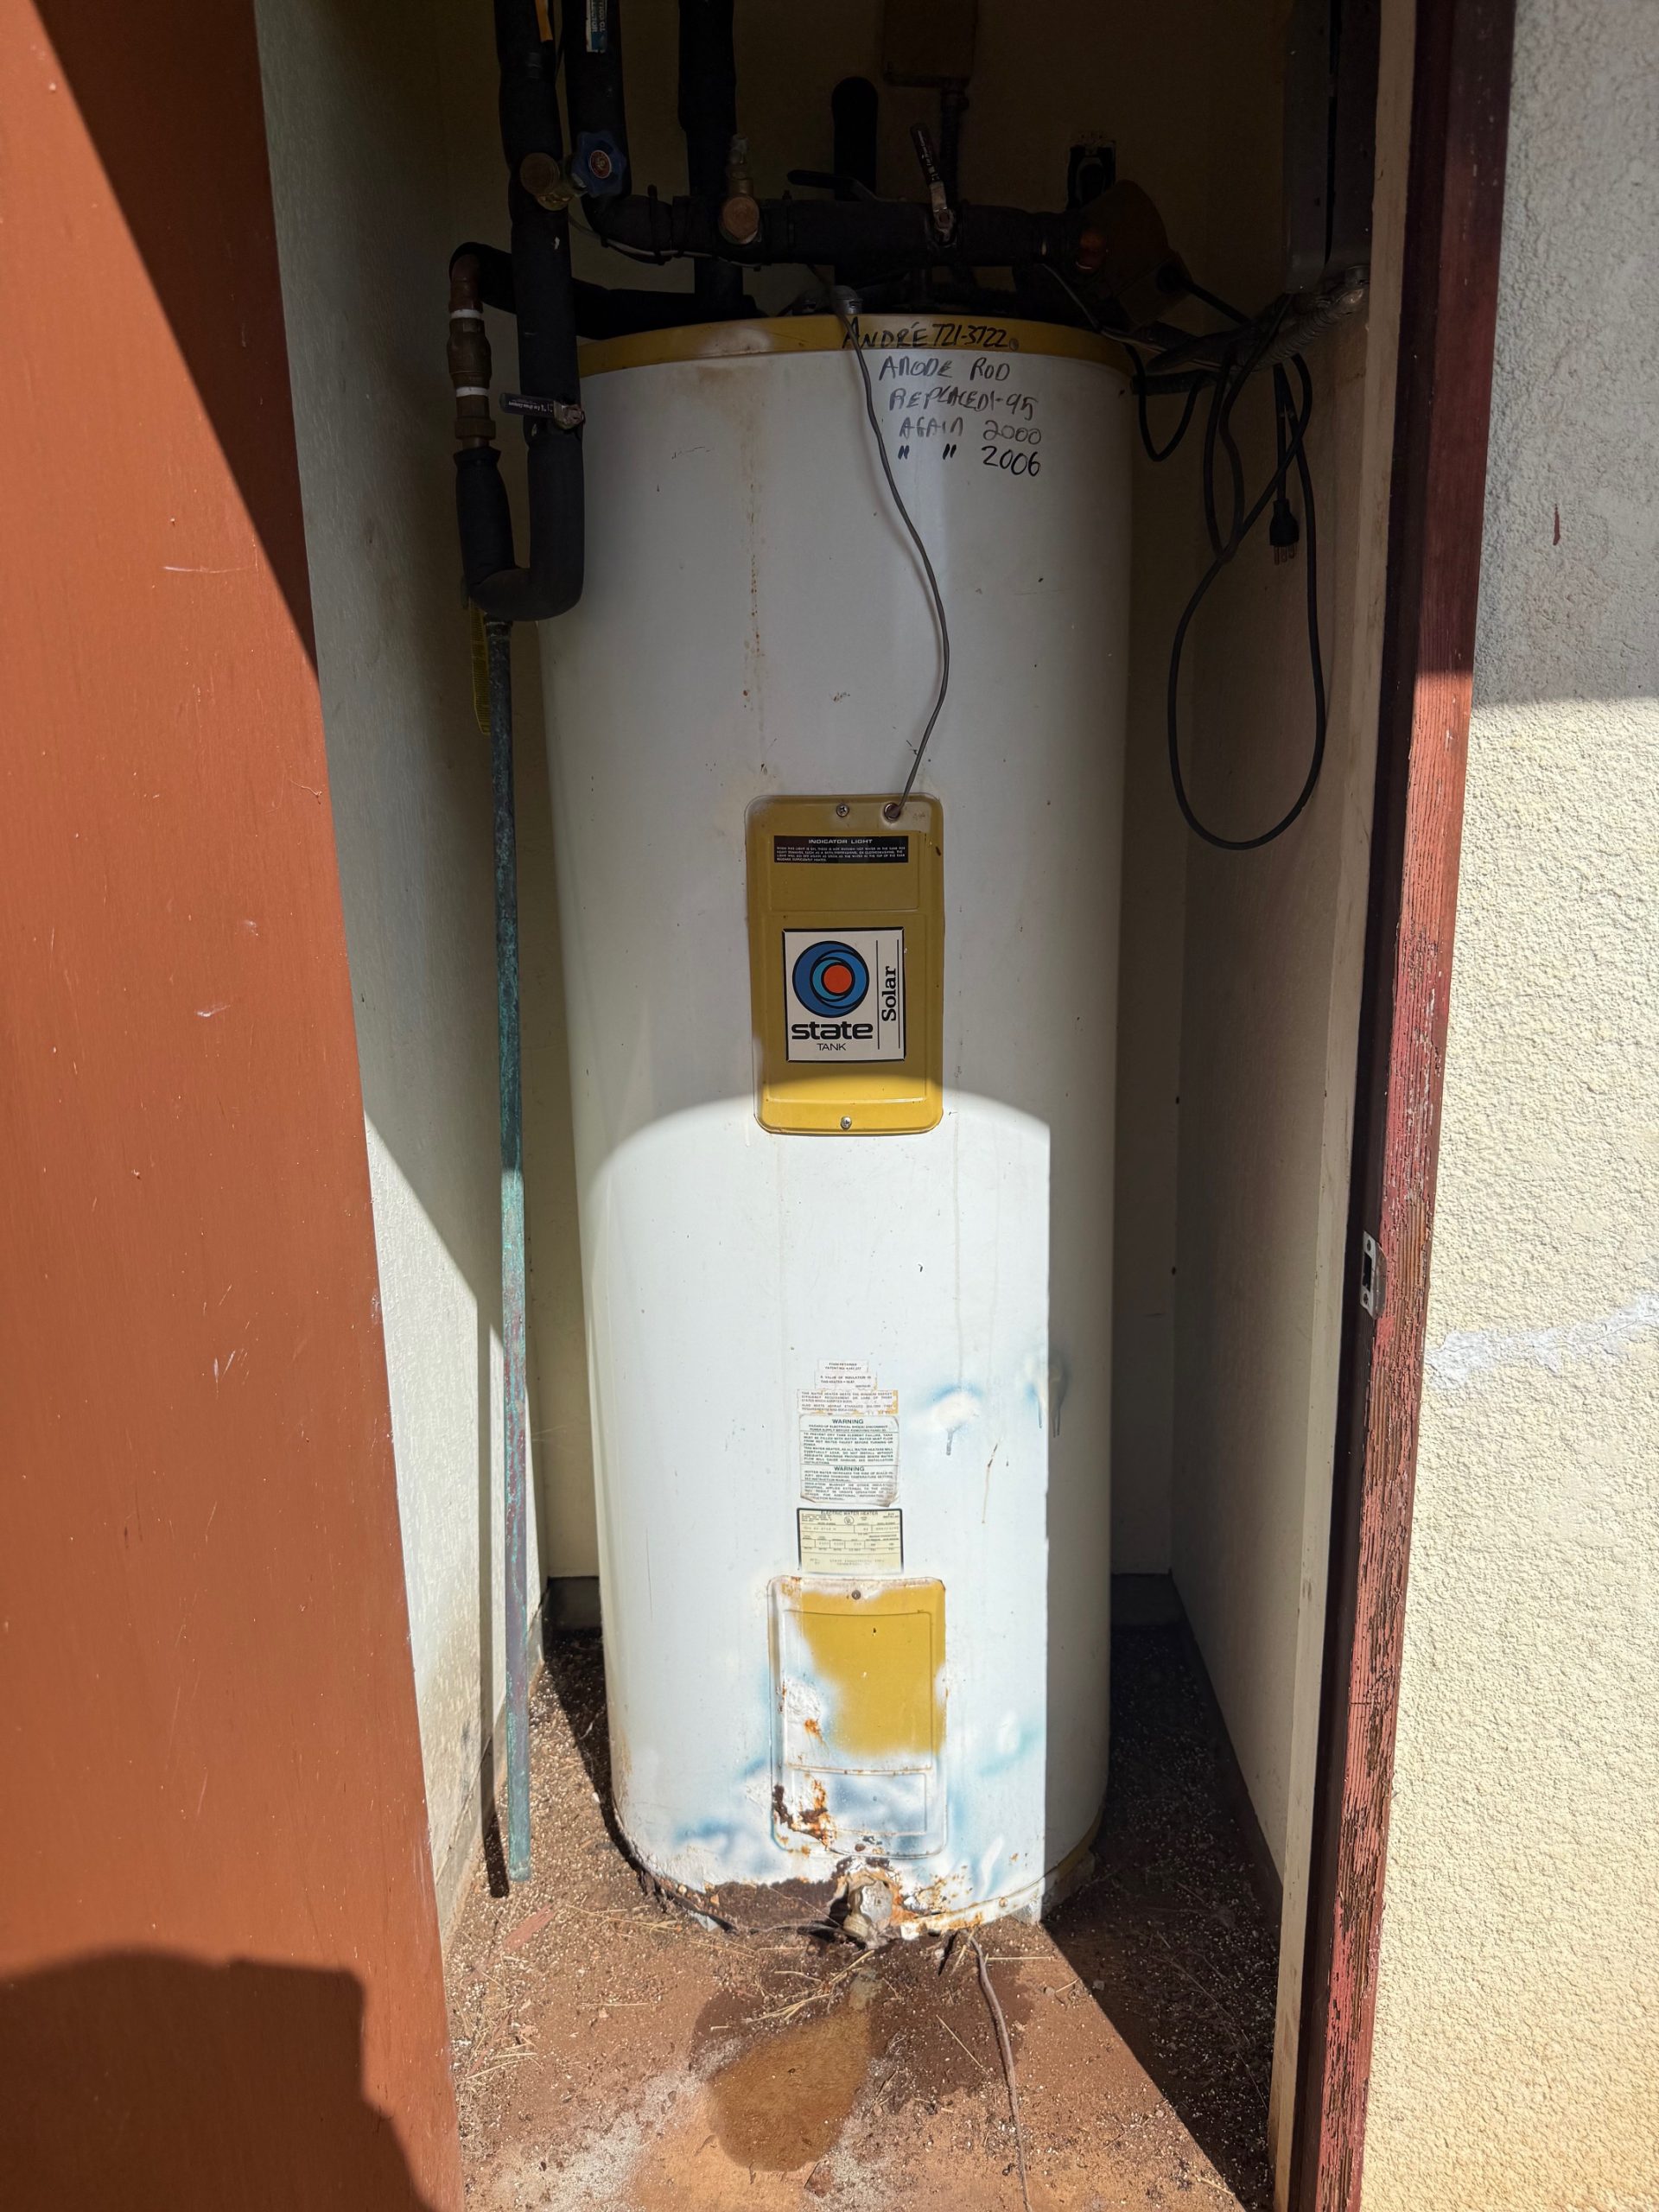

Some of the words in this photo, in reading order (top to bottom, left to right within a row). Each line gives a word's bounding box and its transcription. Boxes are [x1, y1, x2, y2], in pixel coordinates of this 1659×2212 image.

[879, 355, 953, 381] ANODE
[969, 357, 1010, 381] ROD
[899, 416, 964, 439] AGAIN
[982, 420, 1042, 445] 2000
[981, 445, 1041, 477] 2006
[881, 965, 898, 1022] Solar
[791, 1020, 874, 1040] state
[817, 1042, 847, 1052] TANK
